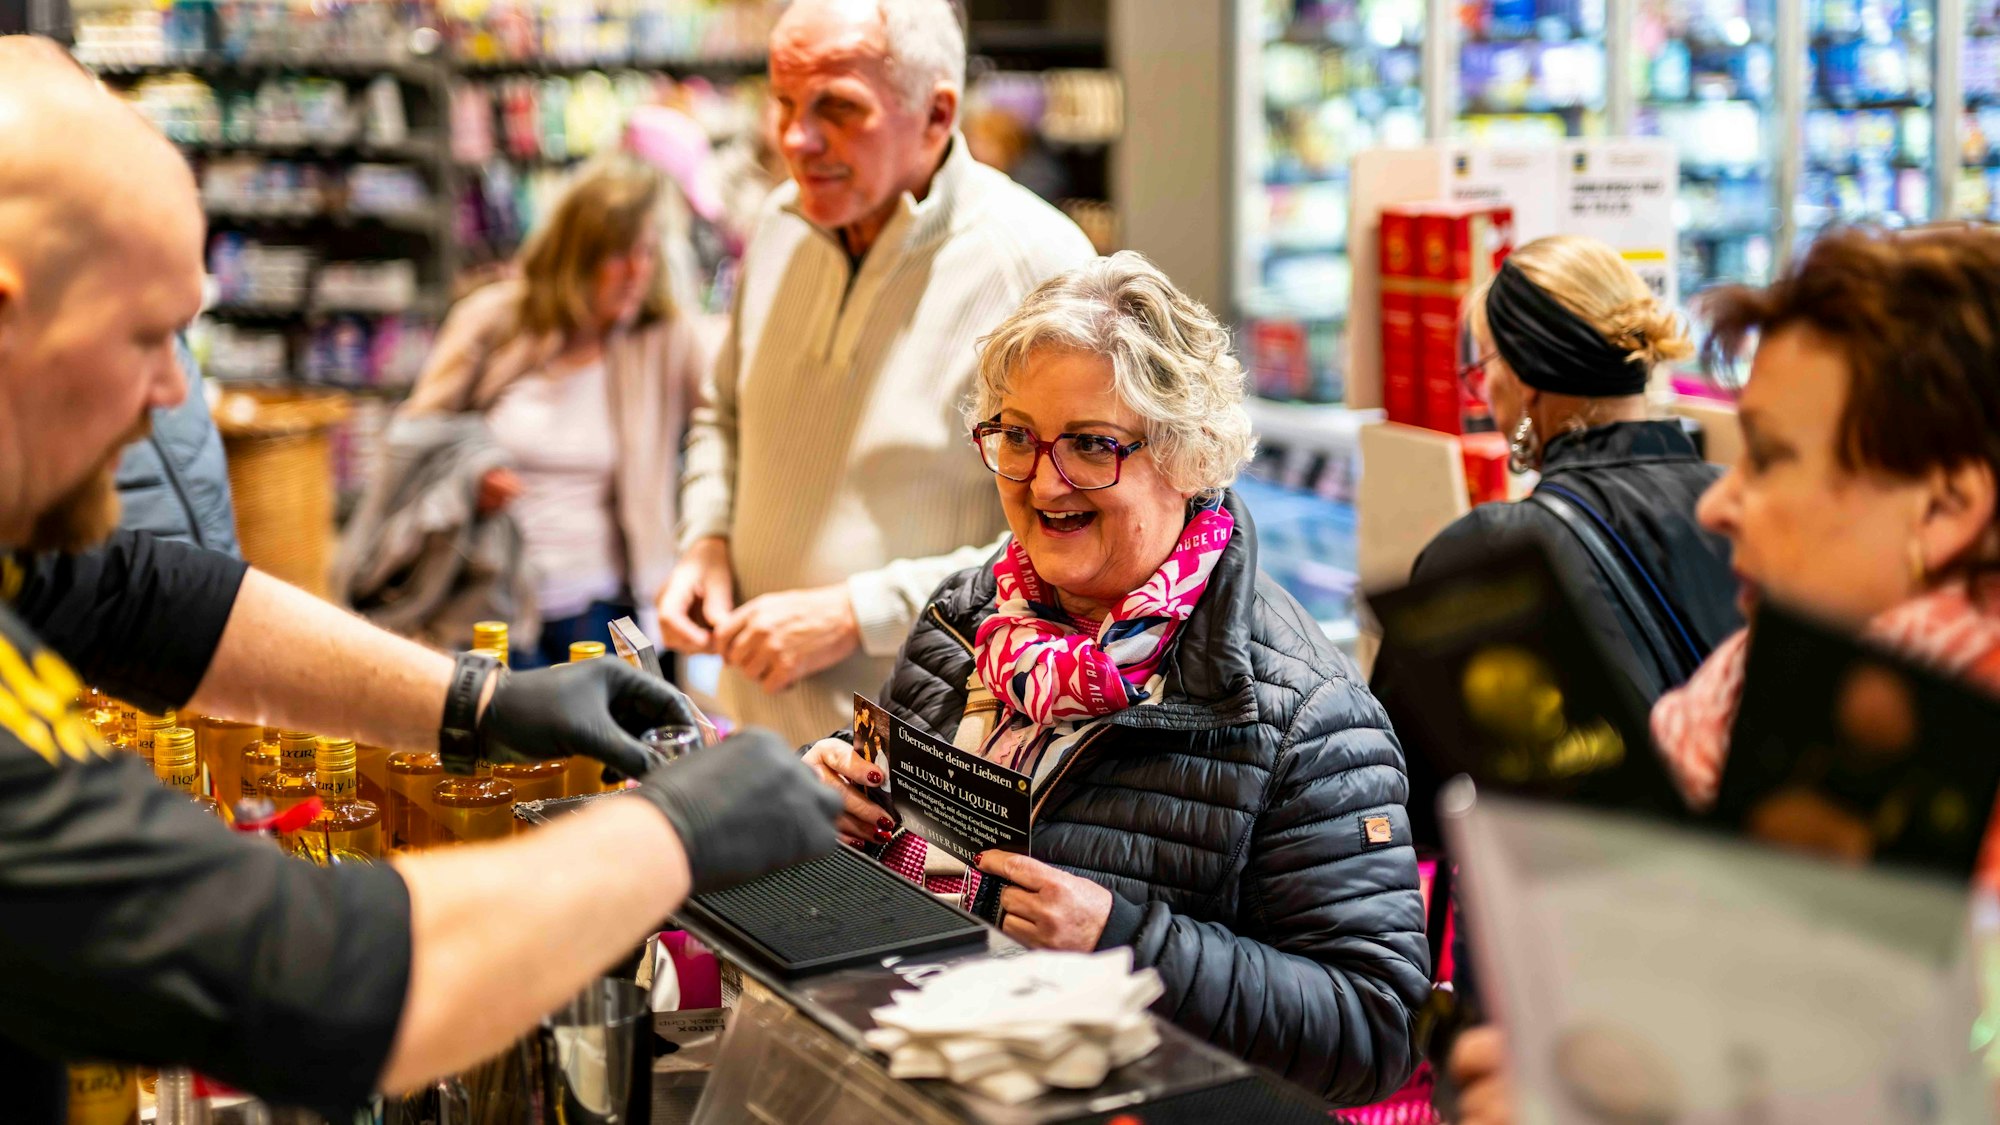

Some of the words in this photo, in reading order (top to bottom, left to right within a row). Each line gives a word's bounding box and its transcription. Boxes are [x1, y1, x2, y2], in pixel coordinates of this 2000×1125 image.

[898, 726, 944, 760] Überrasche
[945, 752, 971, 772] deine
[972, 763, 1012, 789] Liebsten
[896, 777, 918, 794] Weltweit
[946, 805, 956, 814] mit
[956, 809, 968, 821] dem
[968, 815, 999, 836] Geschmack
[1000, 831, 1012, 841] von
[900, 760, 914, 775] mit
[915, 766, 957, 795] LUXURY
[958, 788, 1009, 819] LIQUEUR
[928, 828, 951, 849] HIER
[973, 826, 997, 845] Mandeln
